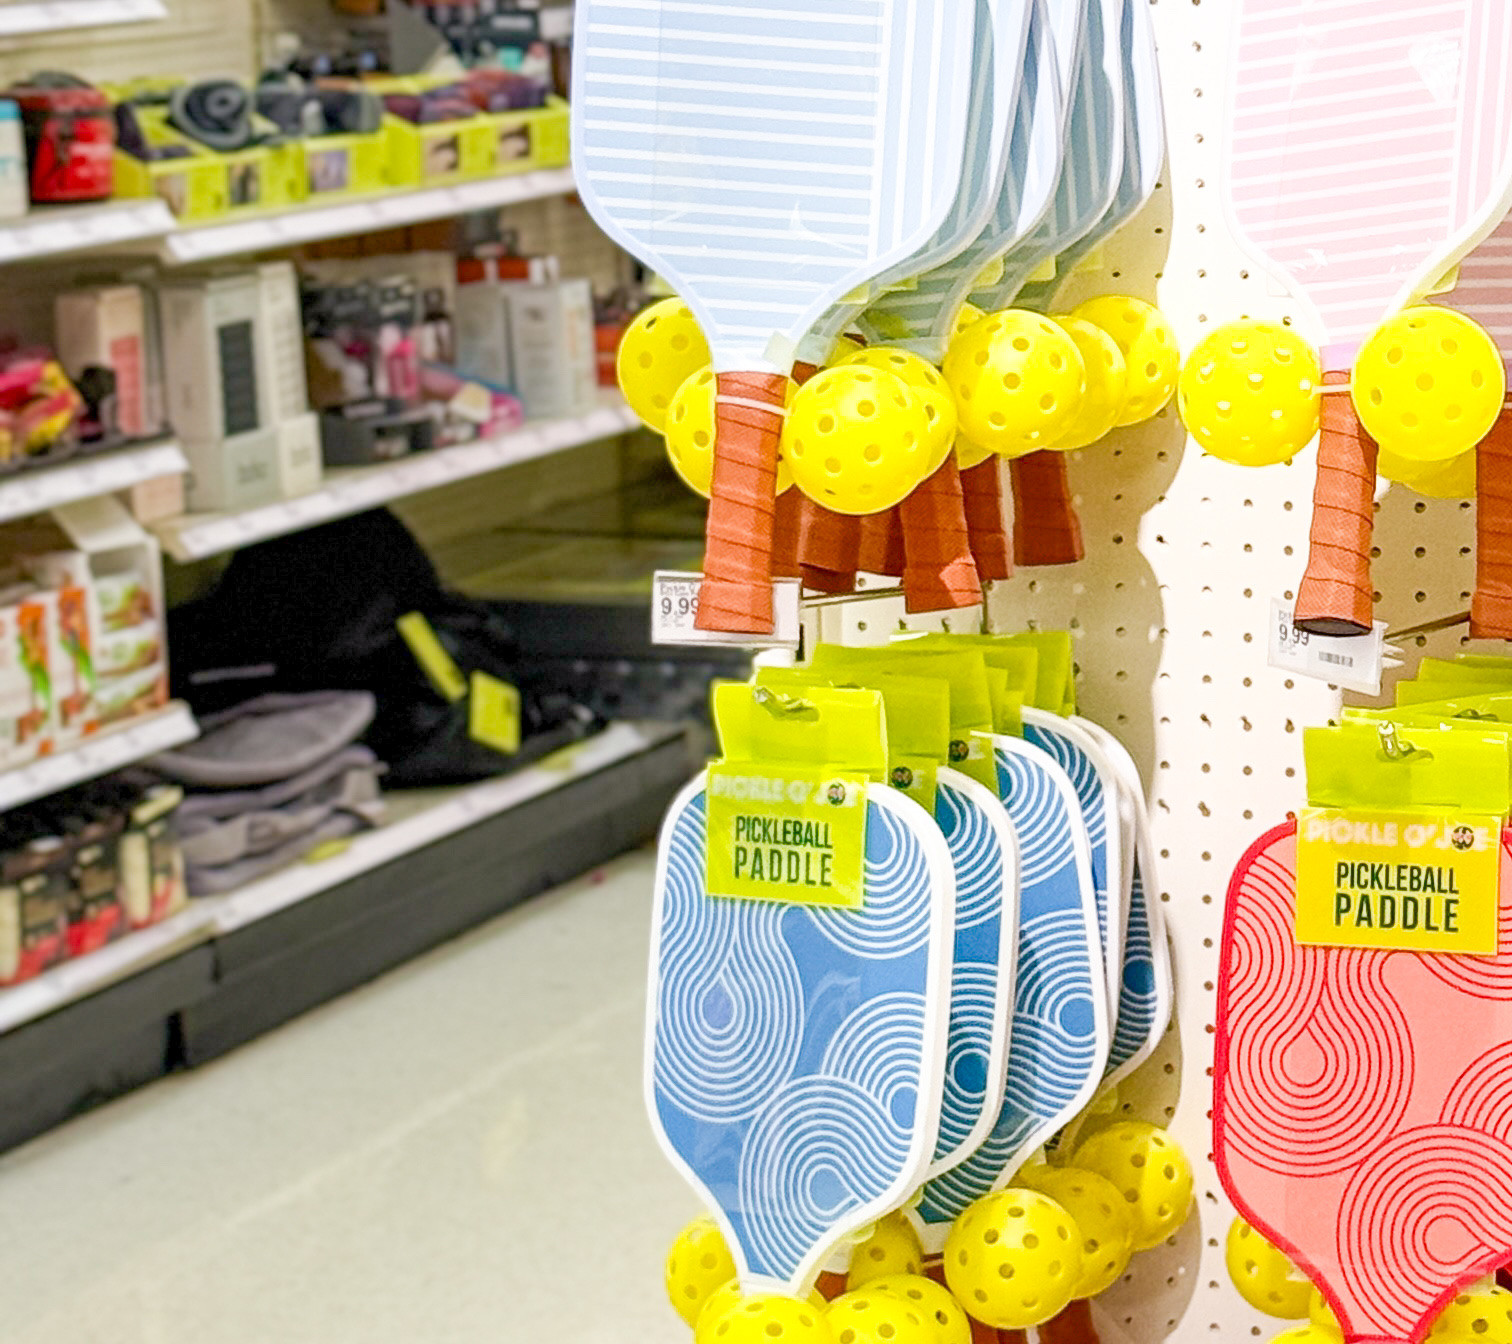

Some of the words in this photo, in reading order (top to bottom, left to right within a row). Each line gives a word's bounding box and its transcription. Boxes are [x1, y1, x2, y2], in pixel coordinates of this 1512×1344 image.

[1279, 623, 1310, 646] 9.99
[735, 815, 833, 848] PICKLEBALL
[1305, 817, 1398, 847] PICKLE
[735, 846, 833, 887] PADDLE
[1336, 861, 1460, 895] PICKLEBALL
[1335, 892, 1460, 933] PADDLE
